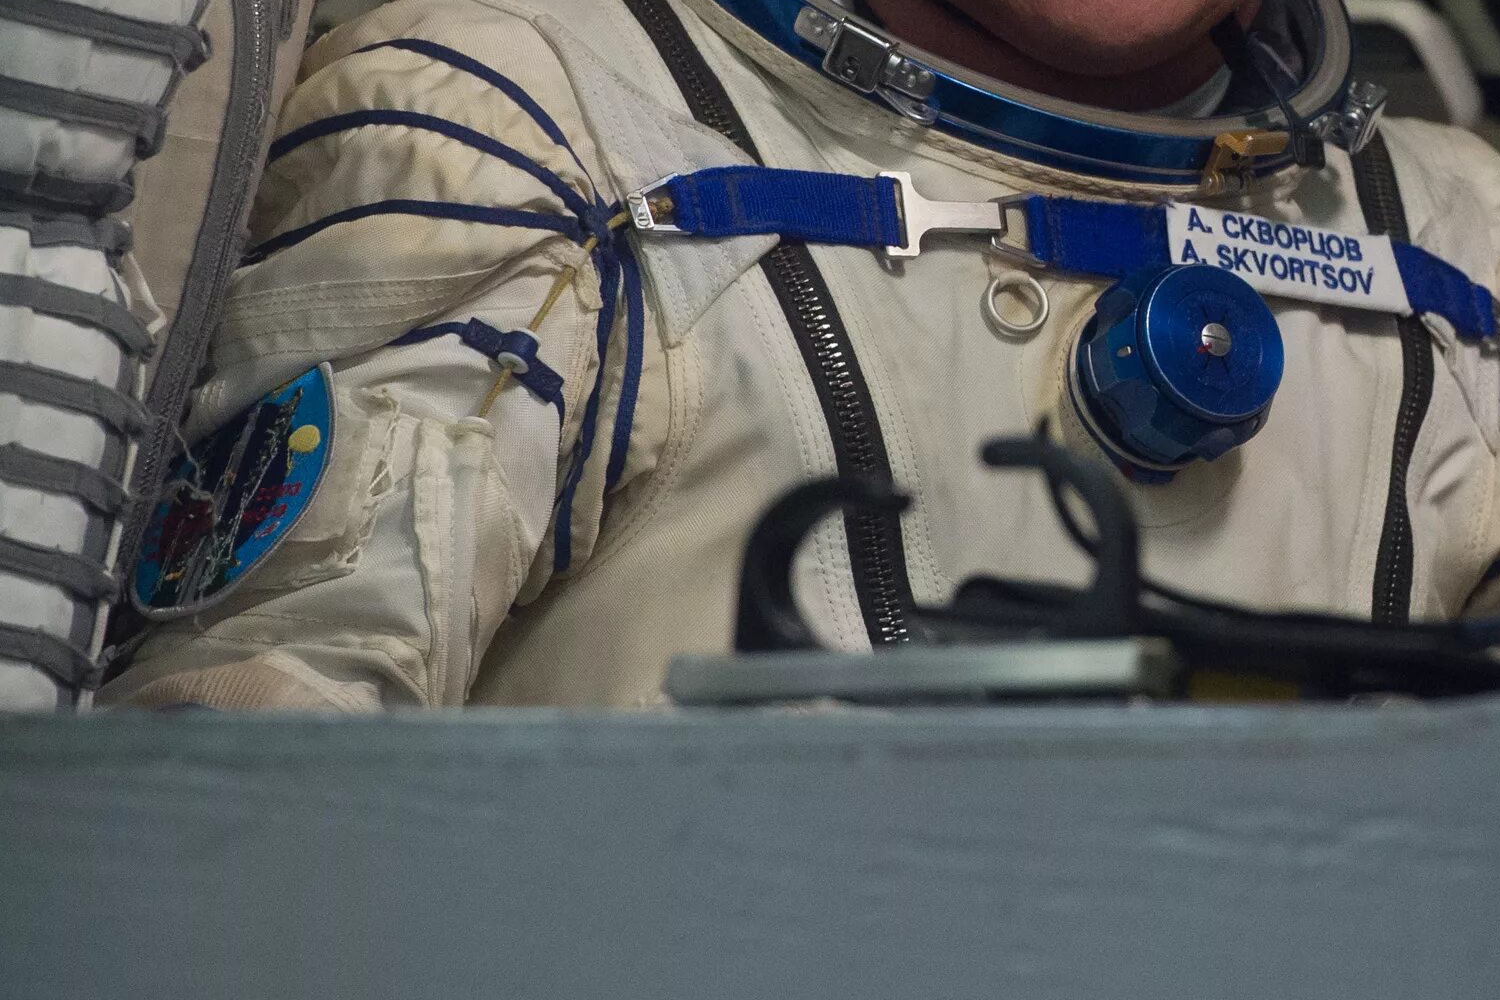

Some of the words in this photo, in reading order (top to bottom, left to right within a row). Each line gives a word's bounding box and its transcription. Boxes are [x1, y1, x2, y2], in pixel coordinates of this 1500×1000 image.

[1187, 207, 1213, 234] А.
[1222, 213, 1363, 261] СКВОРЦОВ
[1216, 244, 1374, 295] SKVORTSOV
